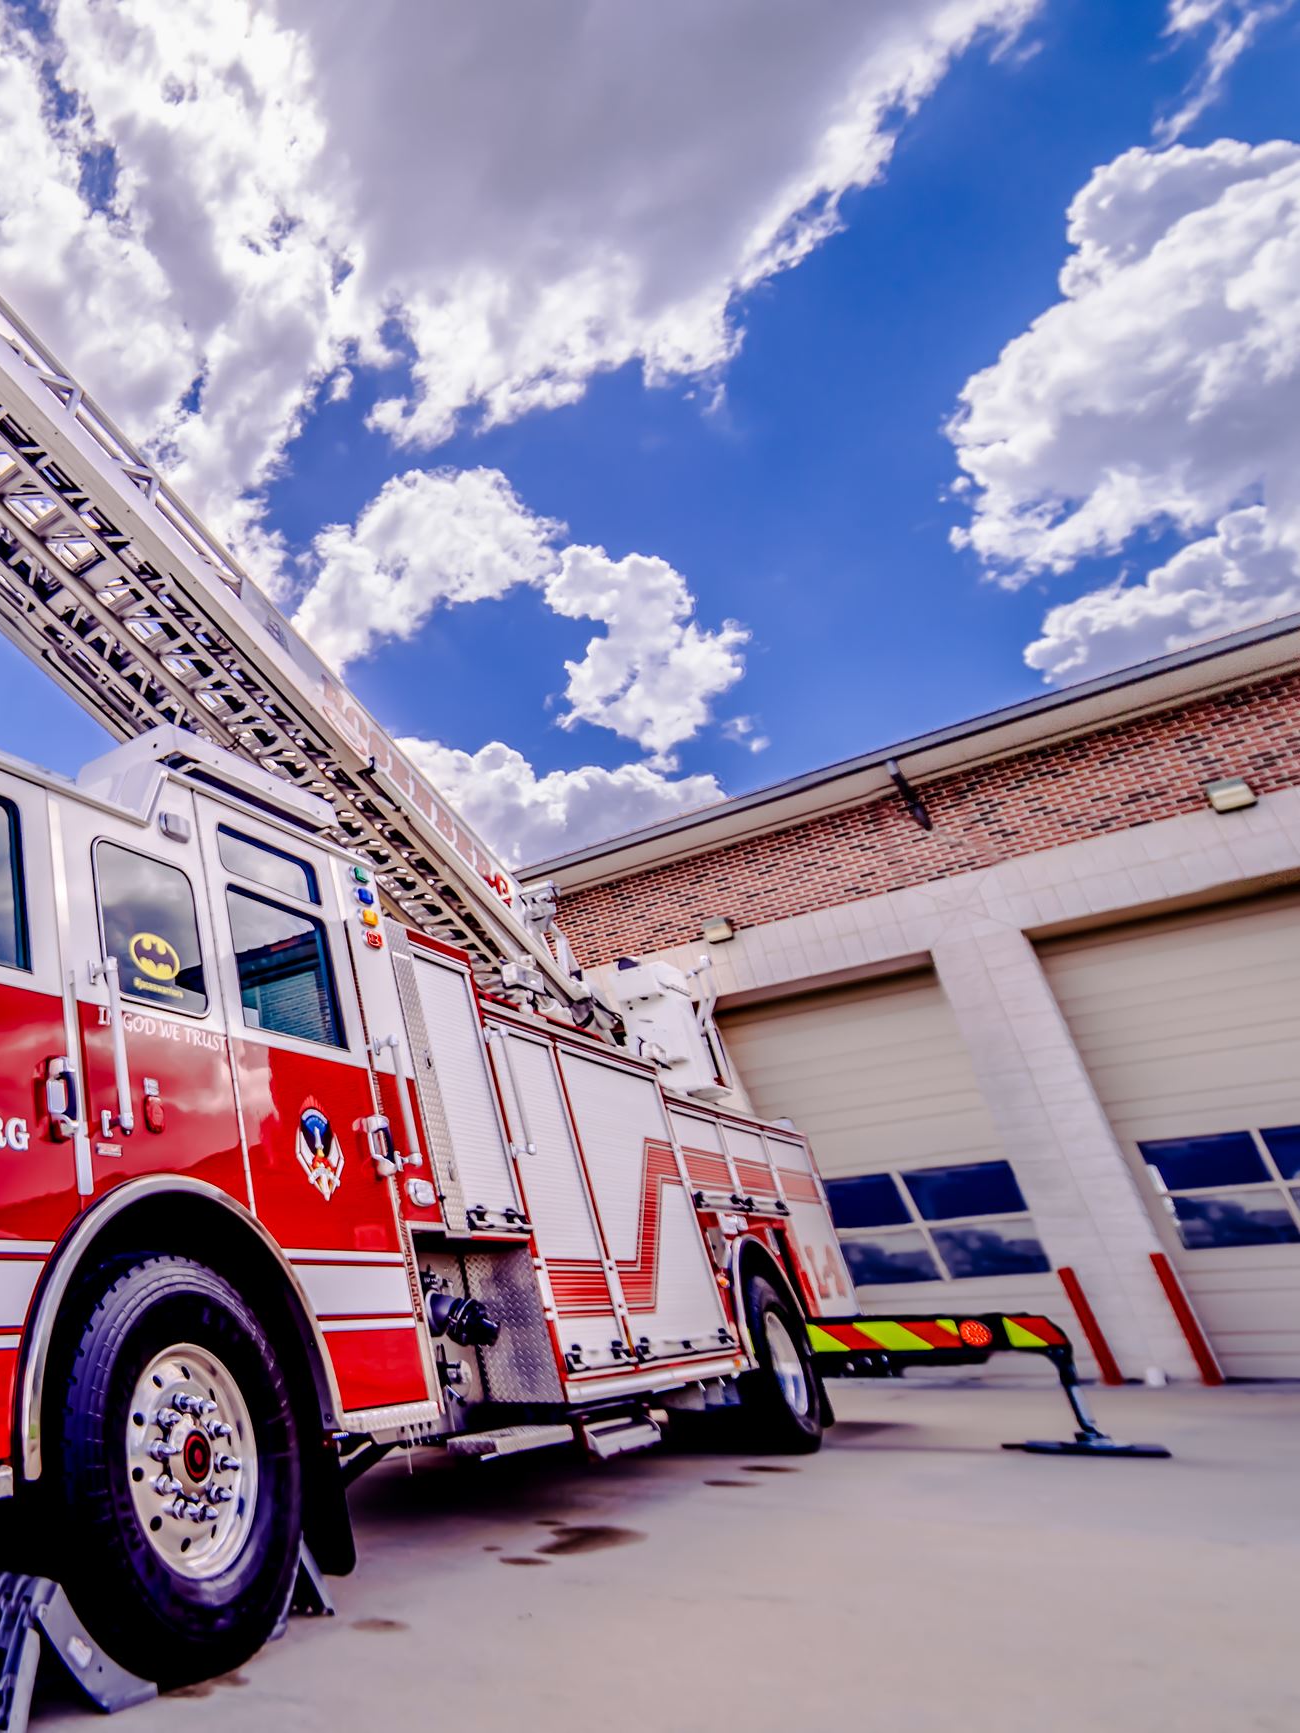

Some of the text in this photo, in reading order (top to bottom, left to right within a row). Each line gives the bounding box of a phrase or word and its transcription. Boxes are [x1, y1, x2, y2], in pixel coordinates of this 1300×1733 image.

[123, 1013, 157, 1036] GOD
[159, 1021, 182, 1043] WE
[184, 1027, 228, 1052] TRUST
